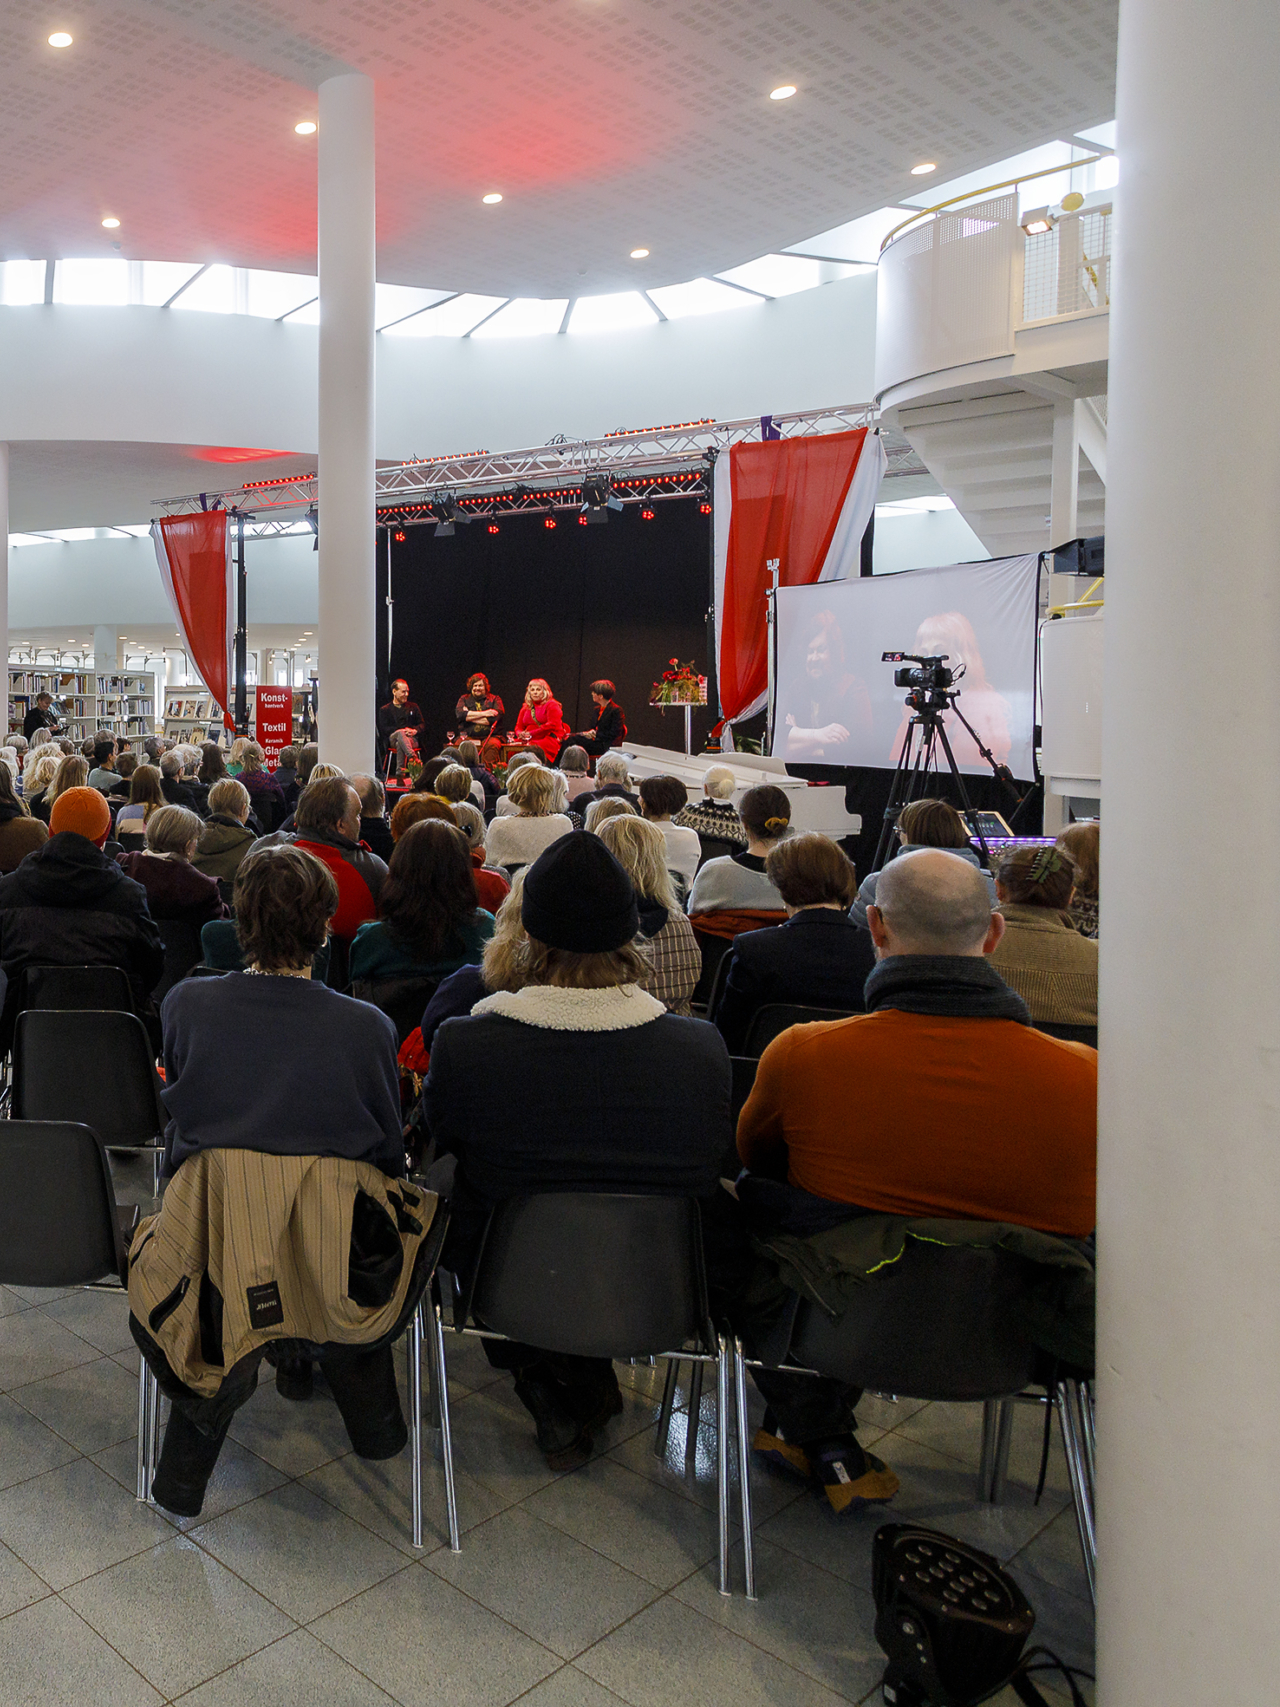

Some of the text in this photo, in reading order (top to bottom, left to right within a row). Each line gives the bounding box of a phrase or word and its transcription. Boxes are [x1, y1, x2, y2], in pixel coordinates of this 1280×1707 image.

[261, 693, 288, 702] Konst-
[262, 723, 287, 732] Textil
[265, 746, 281, 755] Gla
